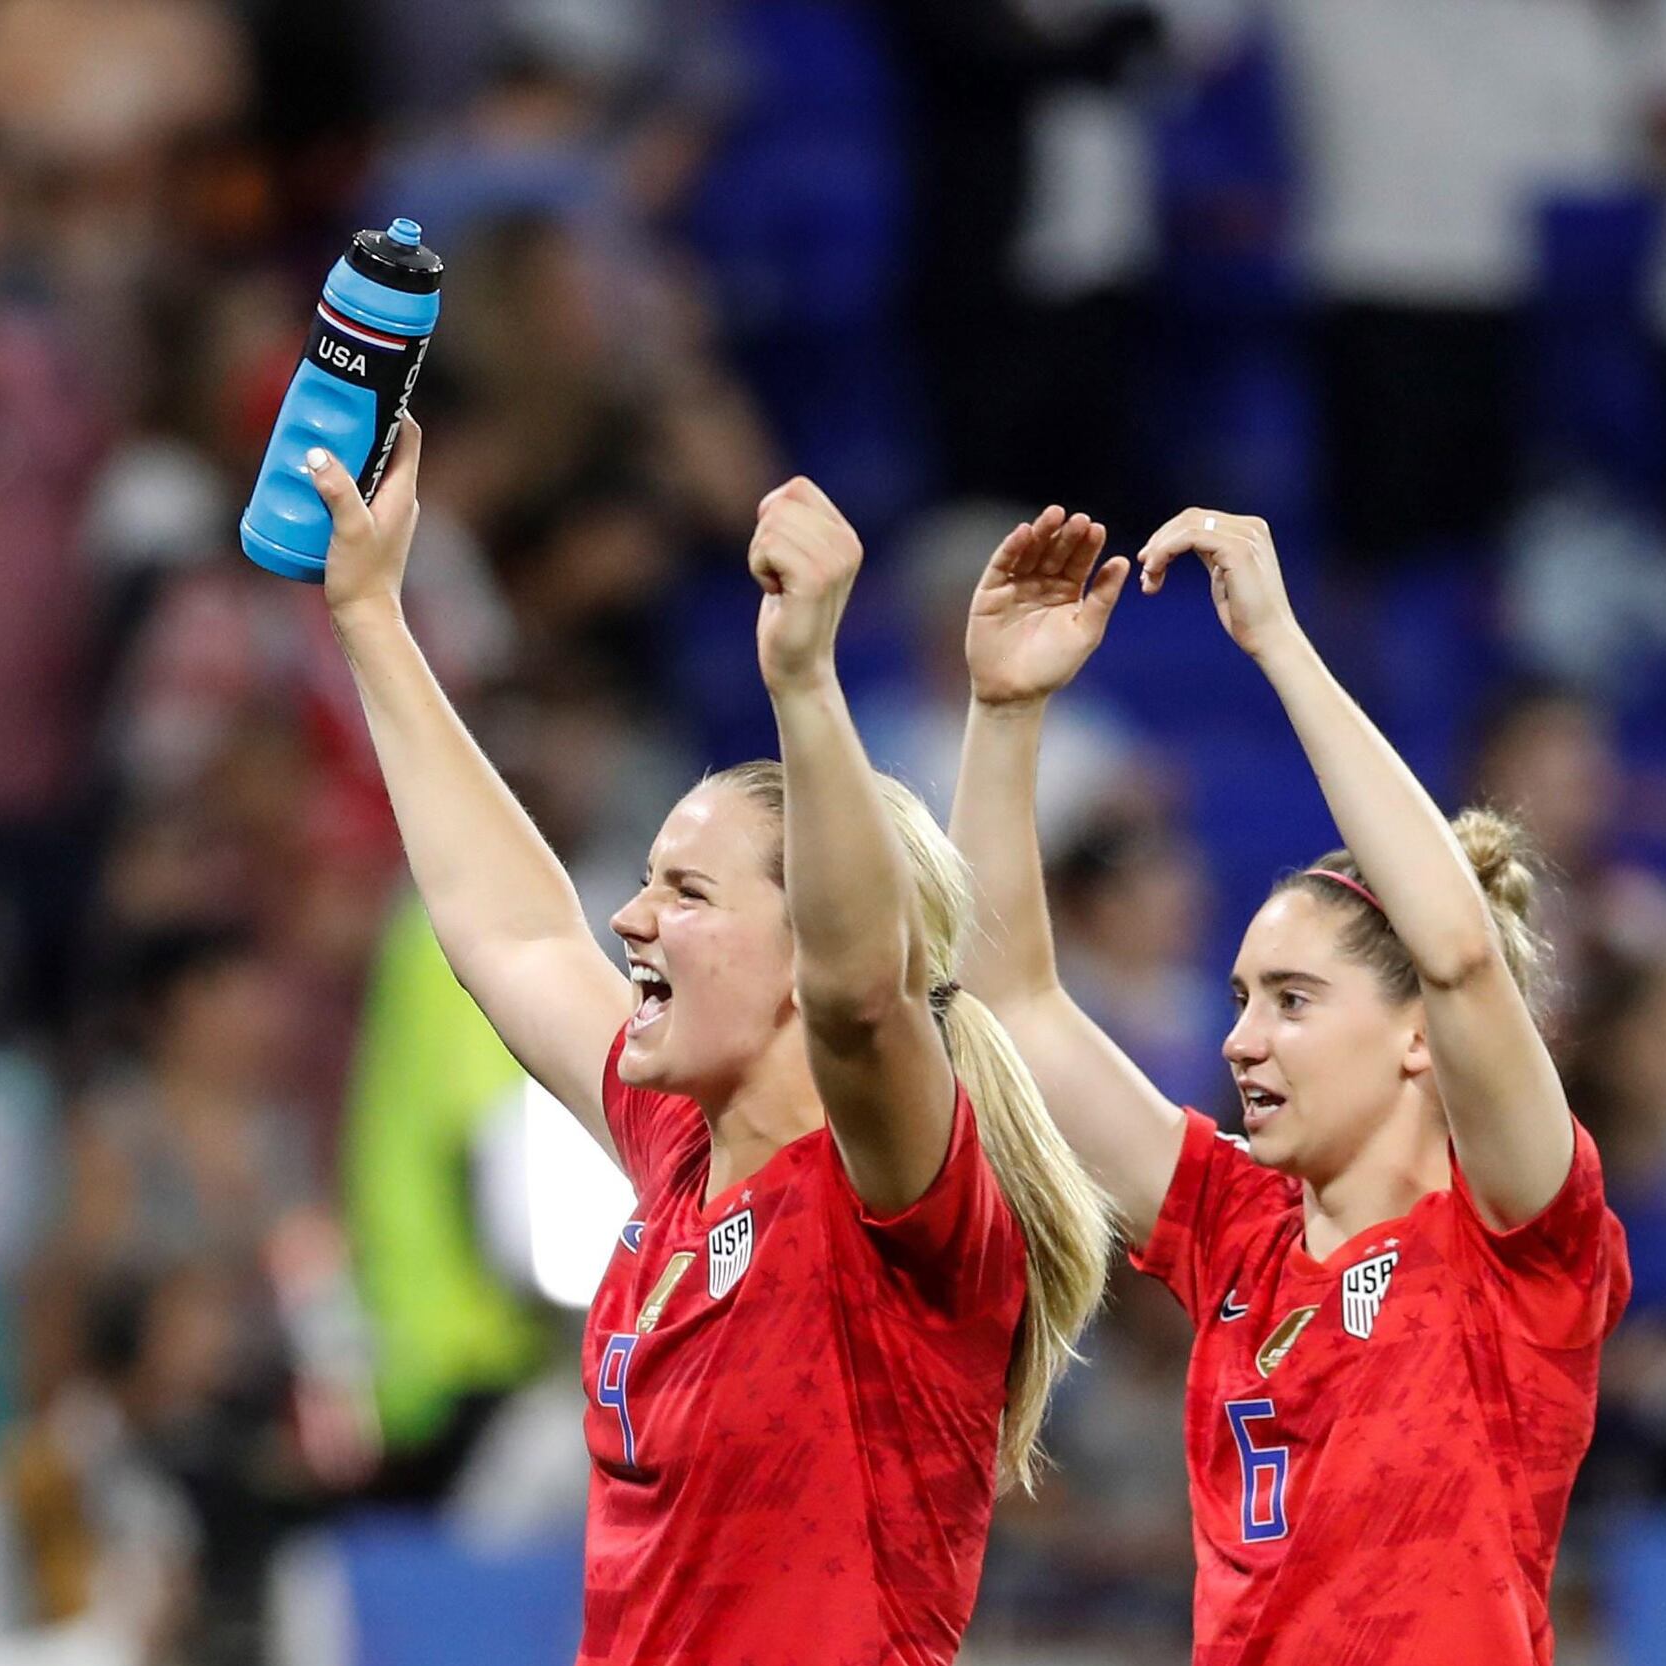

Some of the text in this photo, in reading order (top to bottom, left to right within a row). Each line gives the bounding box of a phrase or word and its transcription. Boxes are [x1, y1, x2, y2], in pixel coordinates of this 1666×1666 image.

[317, 334, 367, 378] USA
[712, 1215, 749, 1256] USA
[1347, 1258, 1393, 1294] USA
[597, 1333, 639, 1467] 9
[1224, 1398, 1289, 1544] 6
